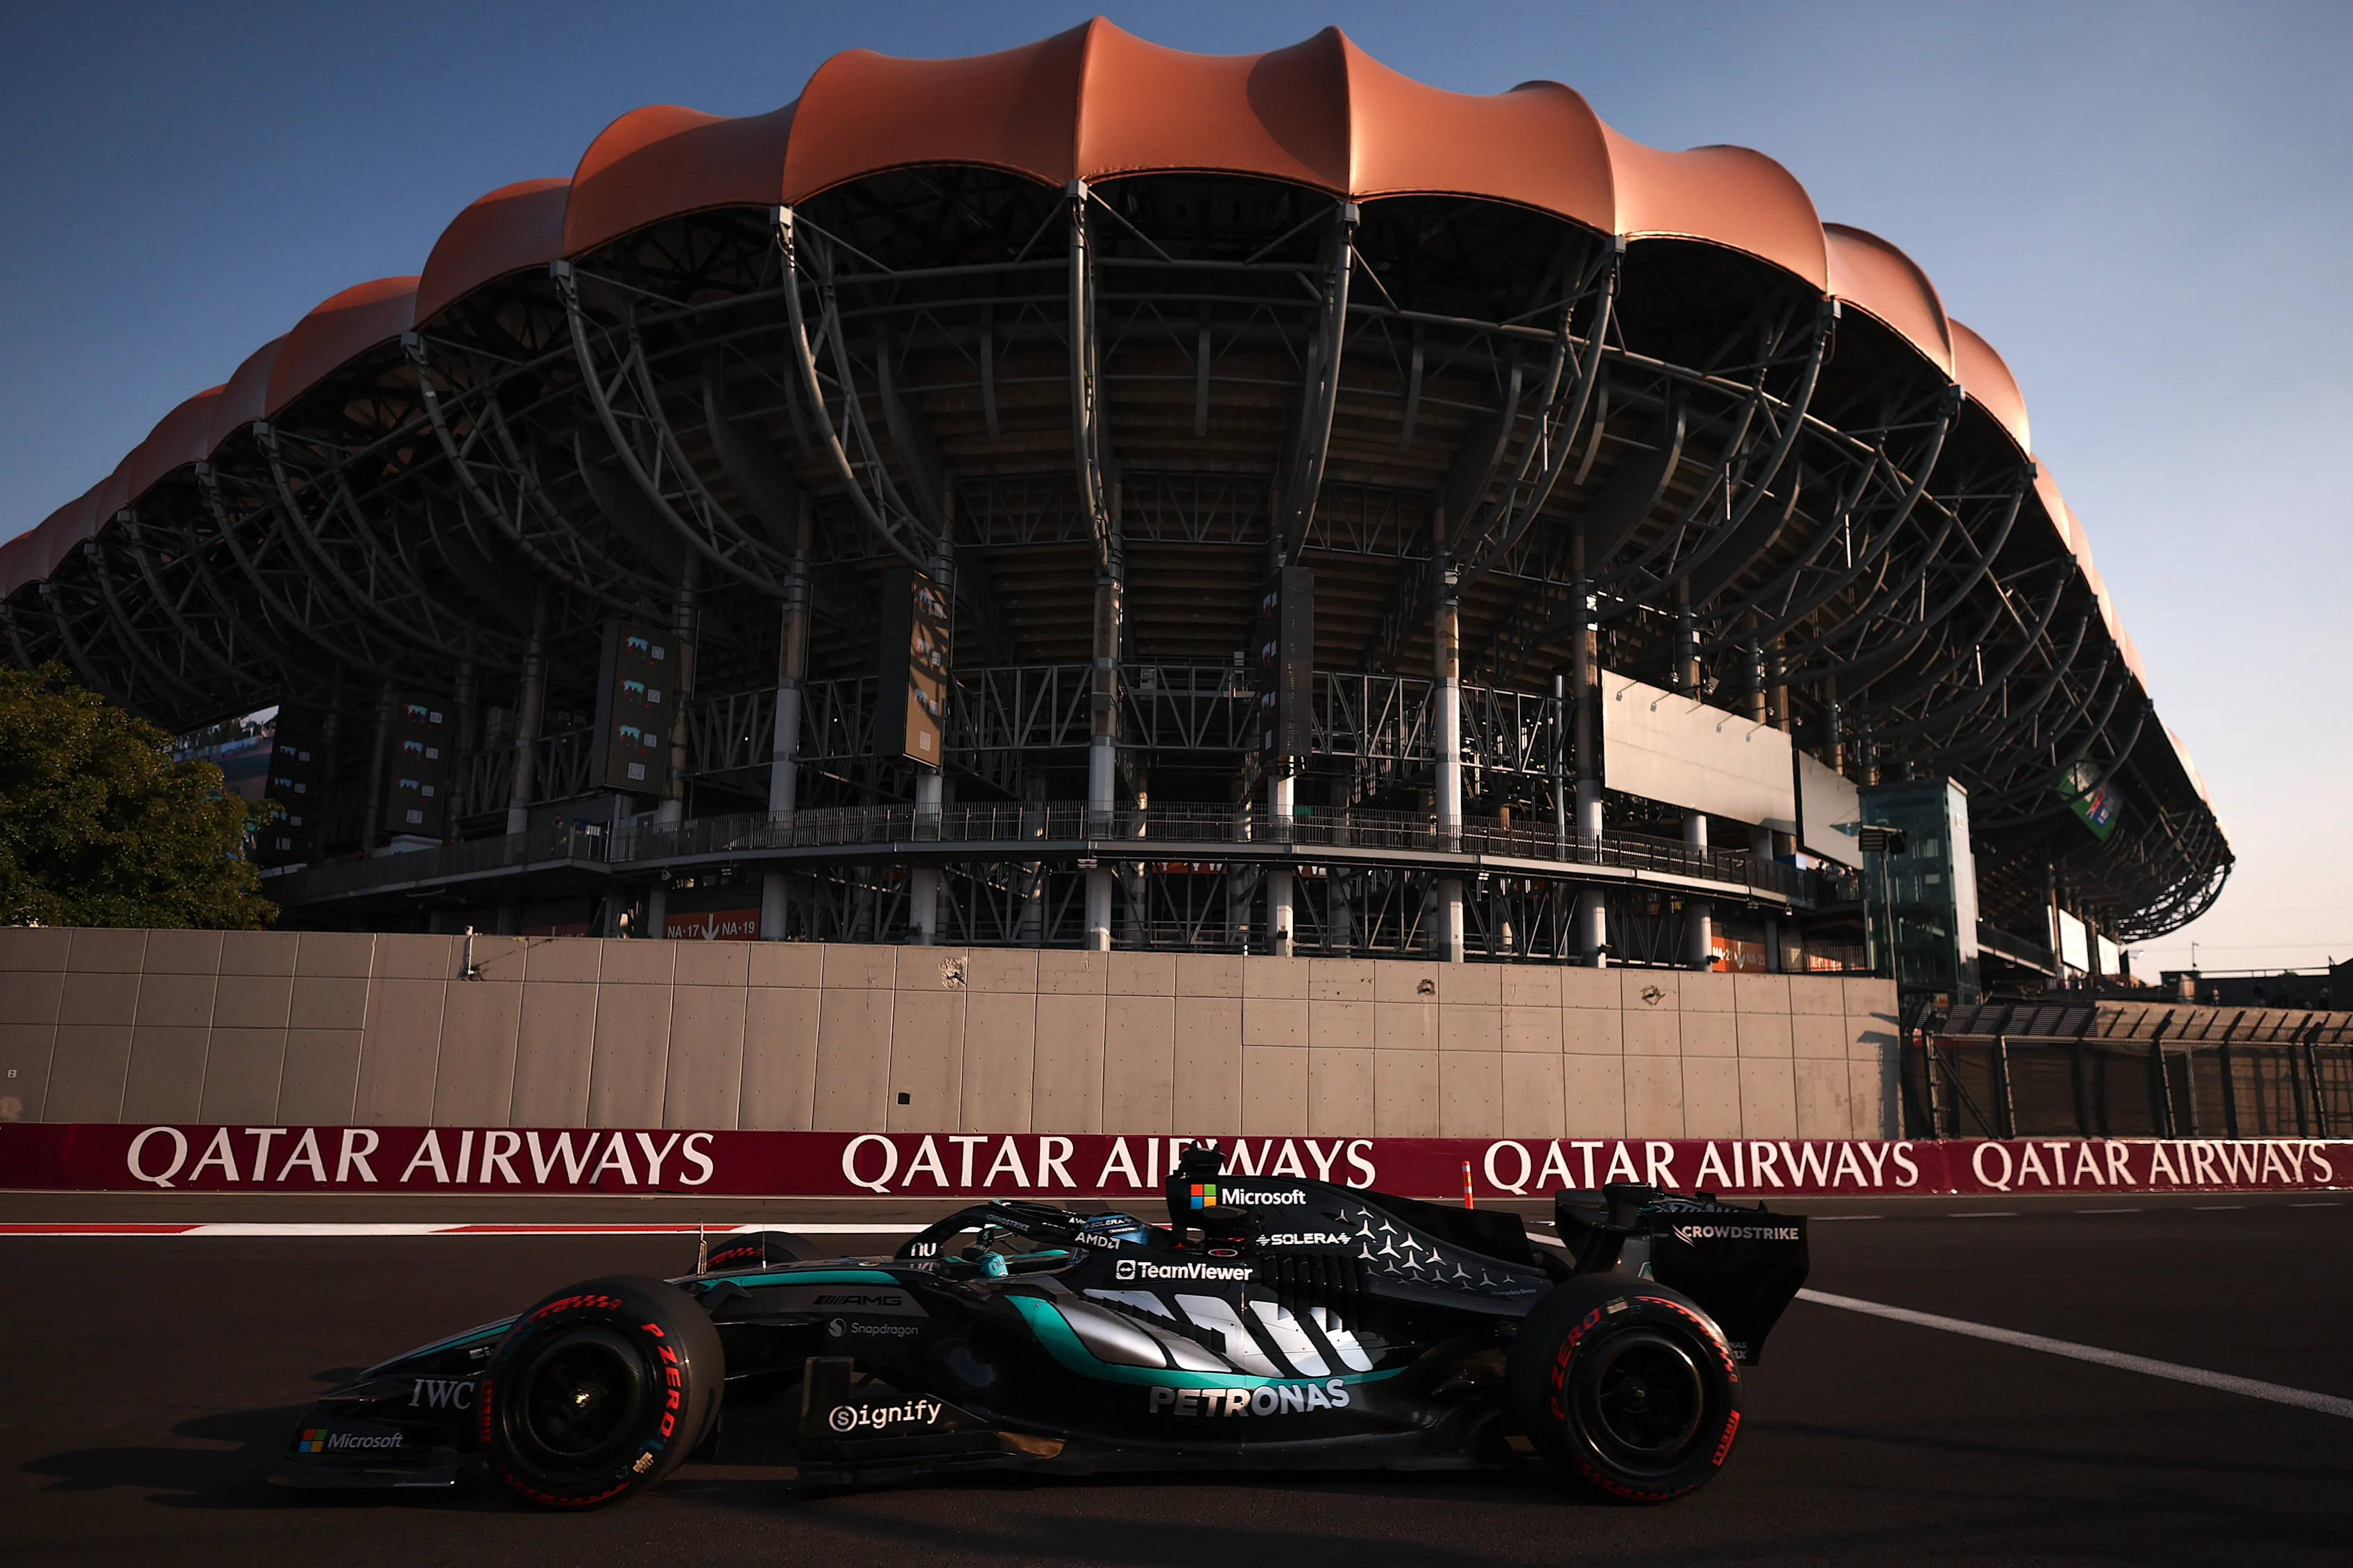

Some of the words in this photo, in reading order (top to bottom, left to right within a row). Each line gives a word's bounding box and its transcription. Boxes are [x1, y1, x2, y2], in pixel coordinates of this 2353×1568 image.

[127, 1127, 379, 1187] QATAR
[400, 1130, 713, 1184] AIRWAYS
[842, 1135, 1077, 1193] QATAR
[1972, 1141, 2137, 1191] QATAR
[2148, 1142, 2333, 1185] AIRWAYS
[1484, 1140, 1680, 1195] QATAR
[1695, 1141, 1919, 1187] AIRWAYS
[1222, 1188, 1307, 1205] Microsoft
[1090, 1218, 1124, 1229] SOLERA
[1682, 1225, 1799, 1240] CROWDSTRIKE
[1075, 1232, 1109, 1248] AMD
[1271, 1232, 1338, 1246] SOLERA
[1137, 1261, 1253, 1281] TeamViewer
[841, 1295, 902, 1306] AMG
[850, 1321, 919, 1338] Snapdragon
[1551, 1307, 1602, 1391] ZERO
[408, 1378, 476, 1410] IWC
[656, 1345, 683, 1438] ZERO
[1149, 1378, 1351, 1418] PETRONAS
[327, 1432, 404, 1449] Microsoft
